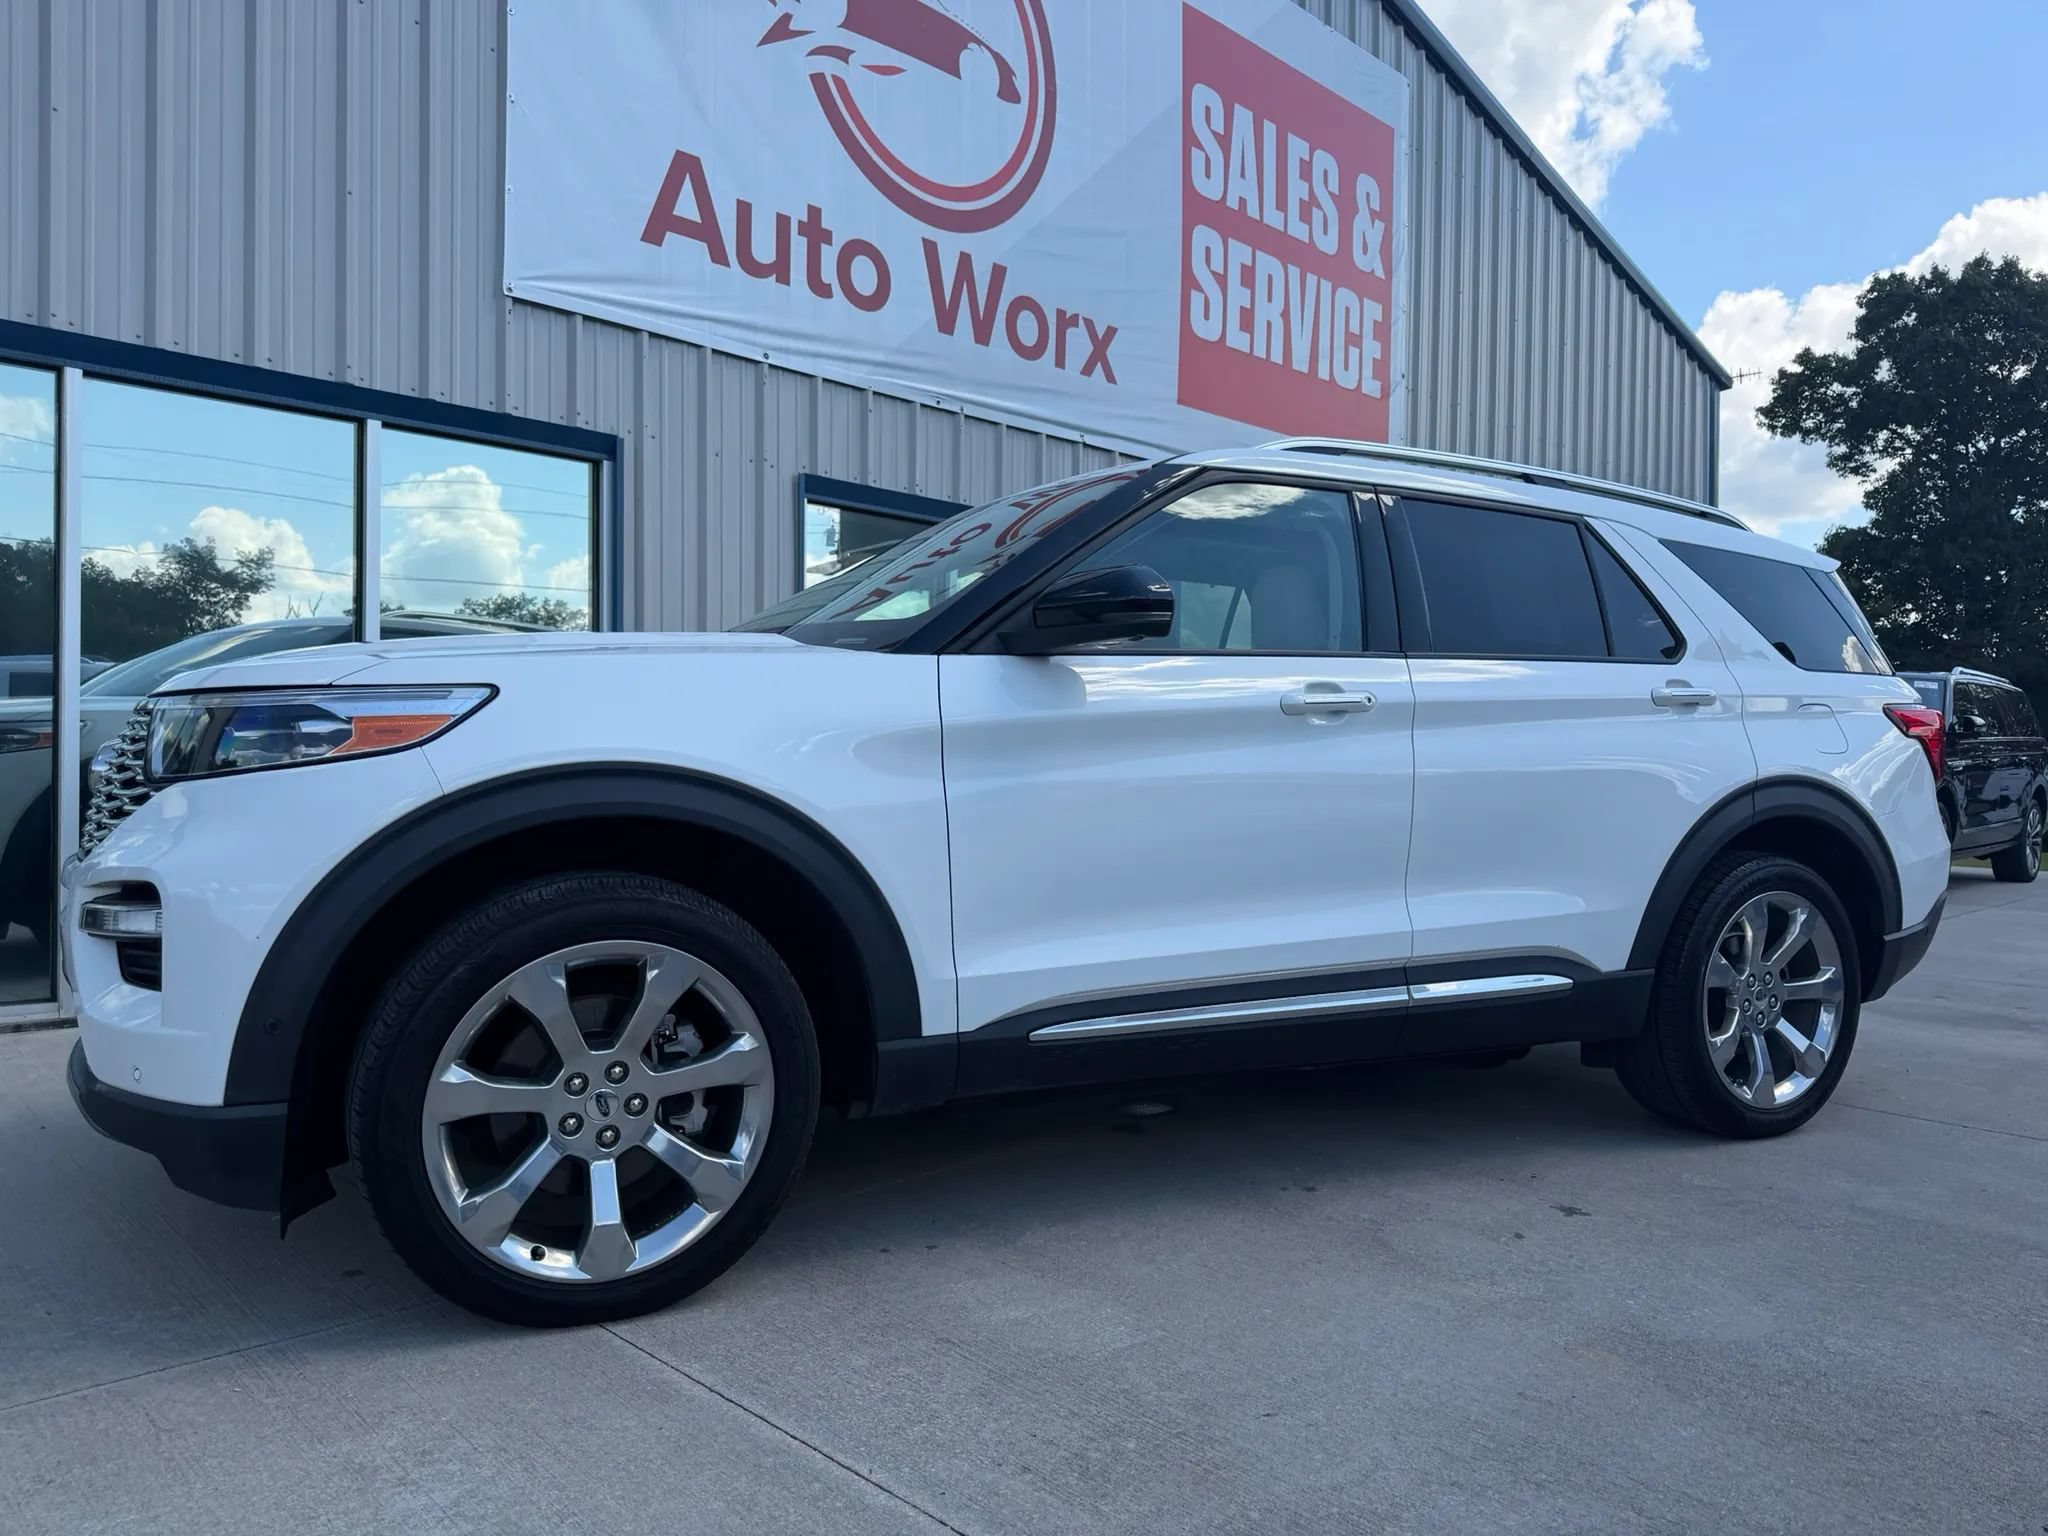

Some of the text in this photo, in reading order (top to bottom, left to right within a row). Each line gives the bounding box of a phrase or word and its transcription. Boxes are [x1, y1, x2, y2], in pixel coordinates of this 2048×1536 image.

[641, 150, 1118, 386] Auto Worx
[1190, 82, 1387, 280] SALES &
[1190, 223, 1384, 400] SERVICE
